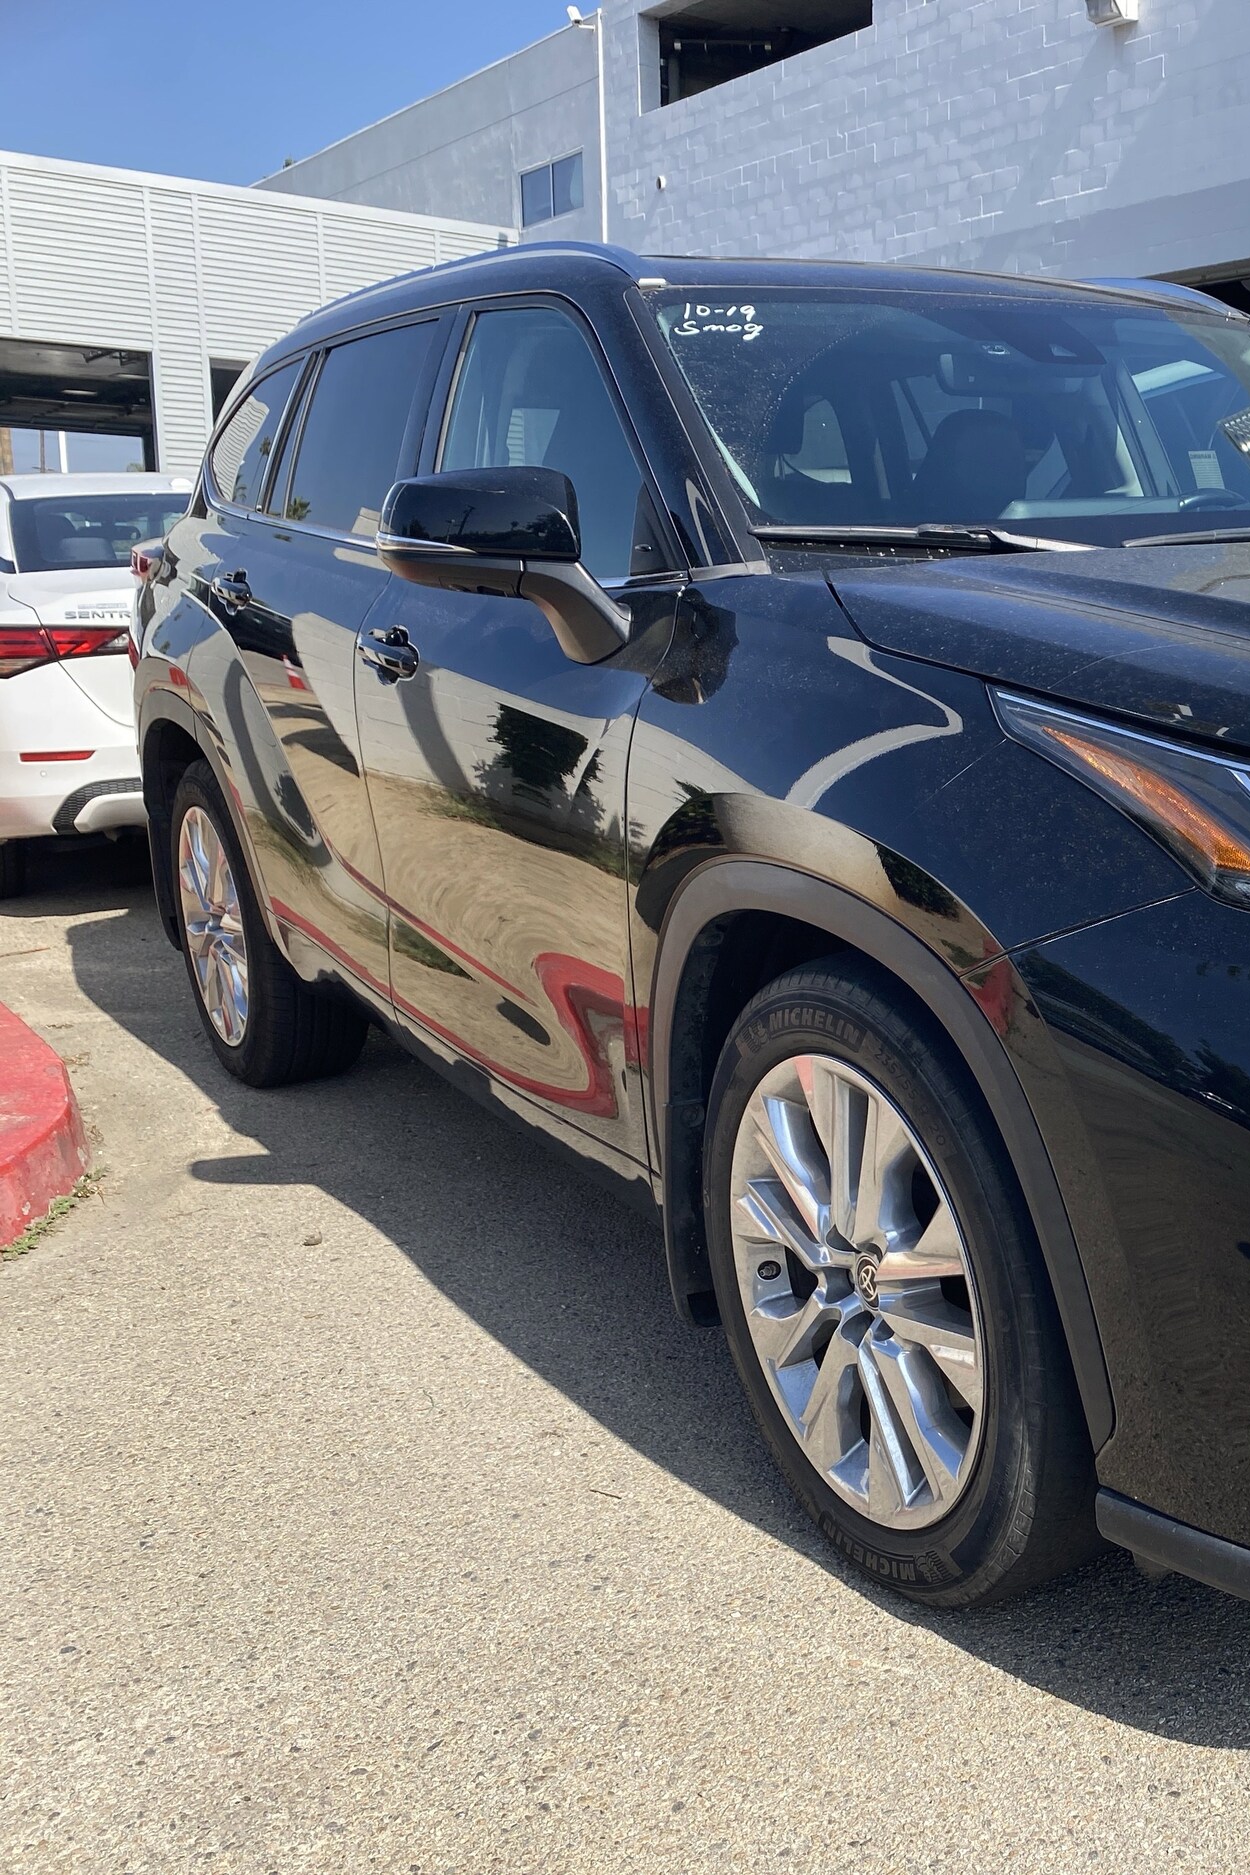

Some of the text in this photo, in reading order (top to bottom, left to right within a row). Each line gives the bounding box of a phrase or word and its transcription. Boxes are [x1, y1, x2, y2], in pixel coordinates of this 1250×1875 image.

[674, 321, 763, 340] Smog
[683, 303, 755, 321] 10-19
[769, 1007, 860, 1046] MICHELIN
[873, 1048, 918, 1099] 235/55
[822, 1517, 916, 1582] MICHELIN
